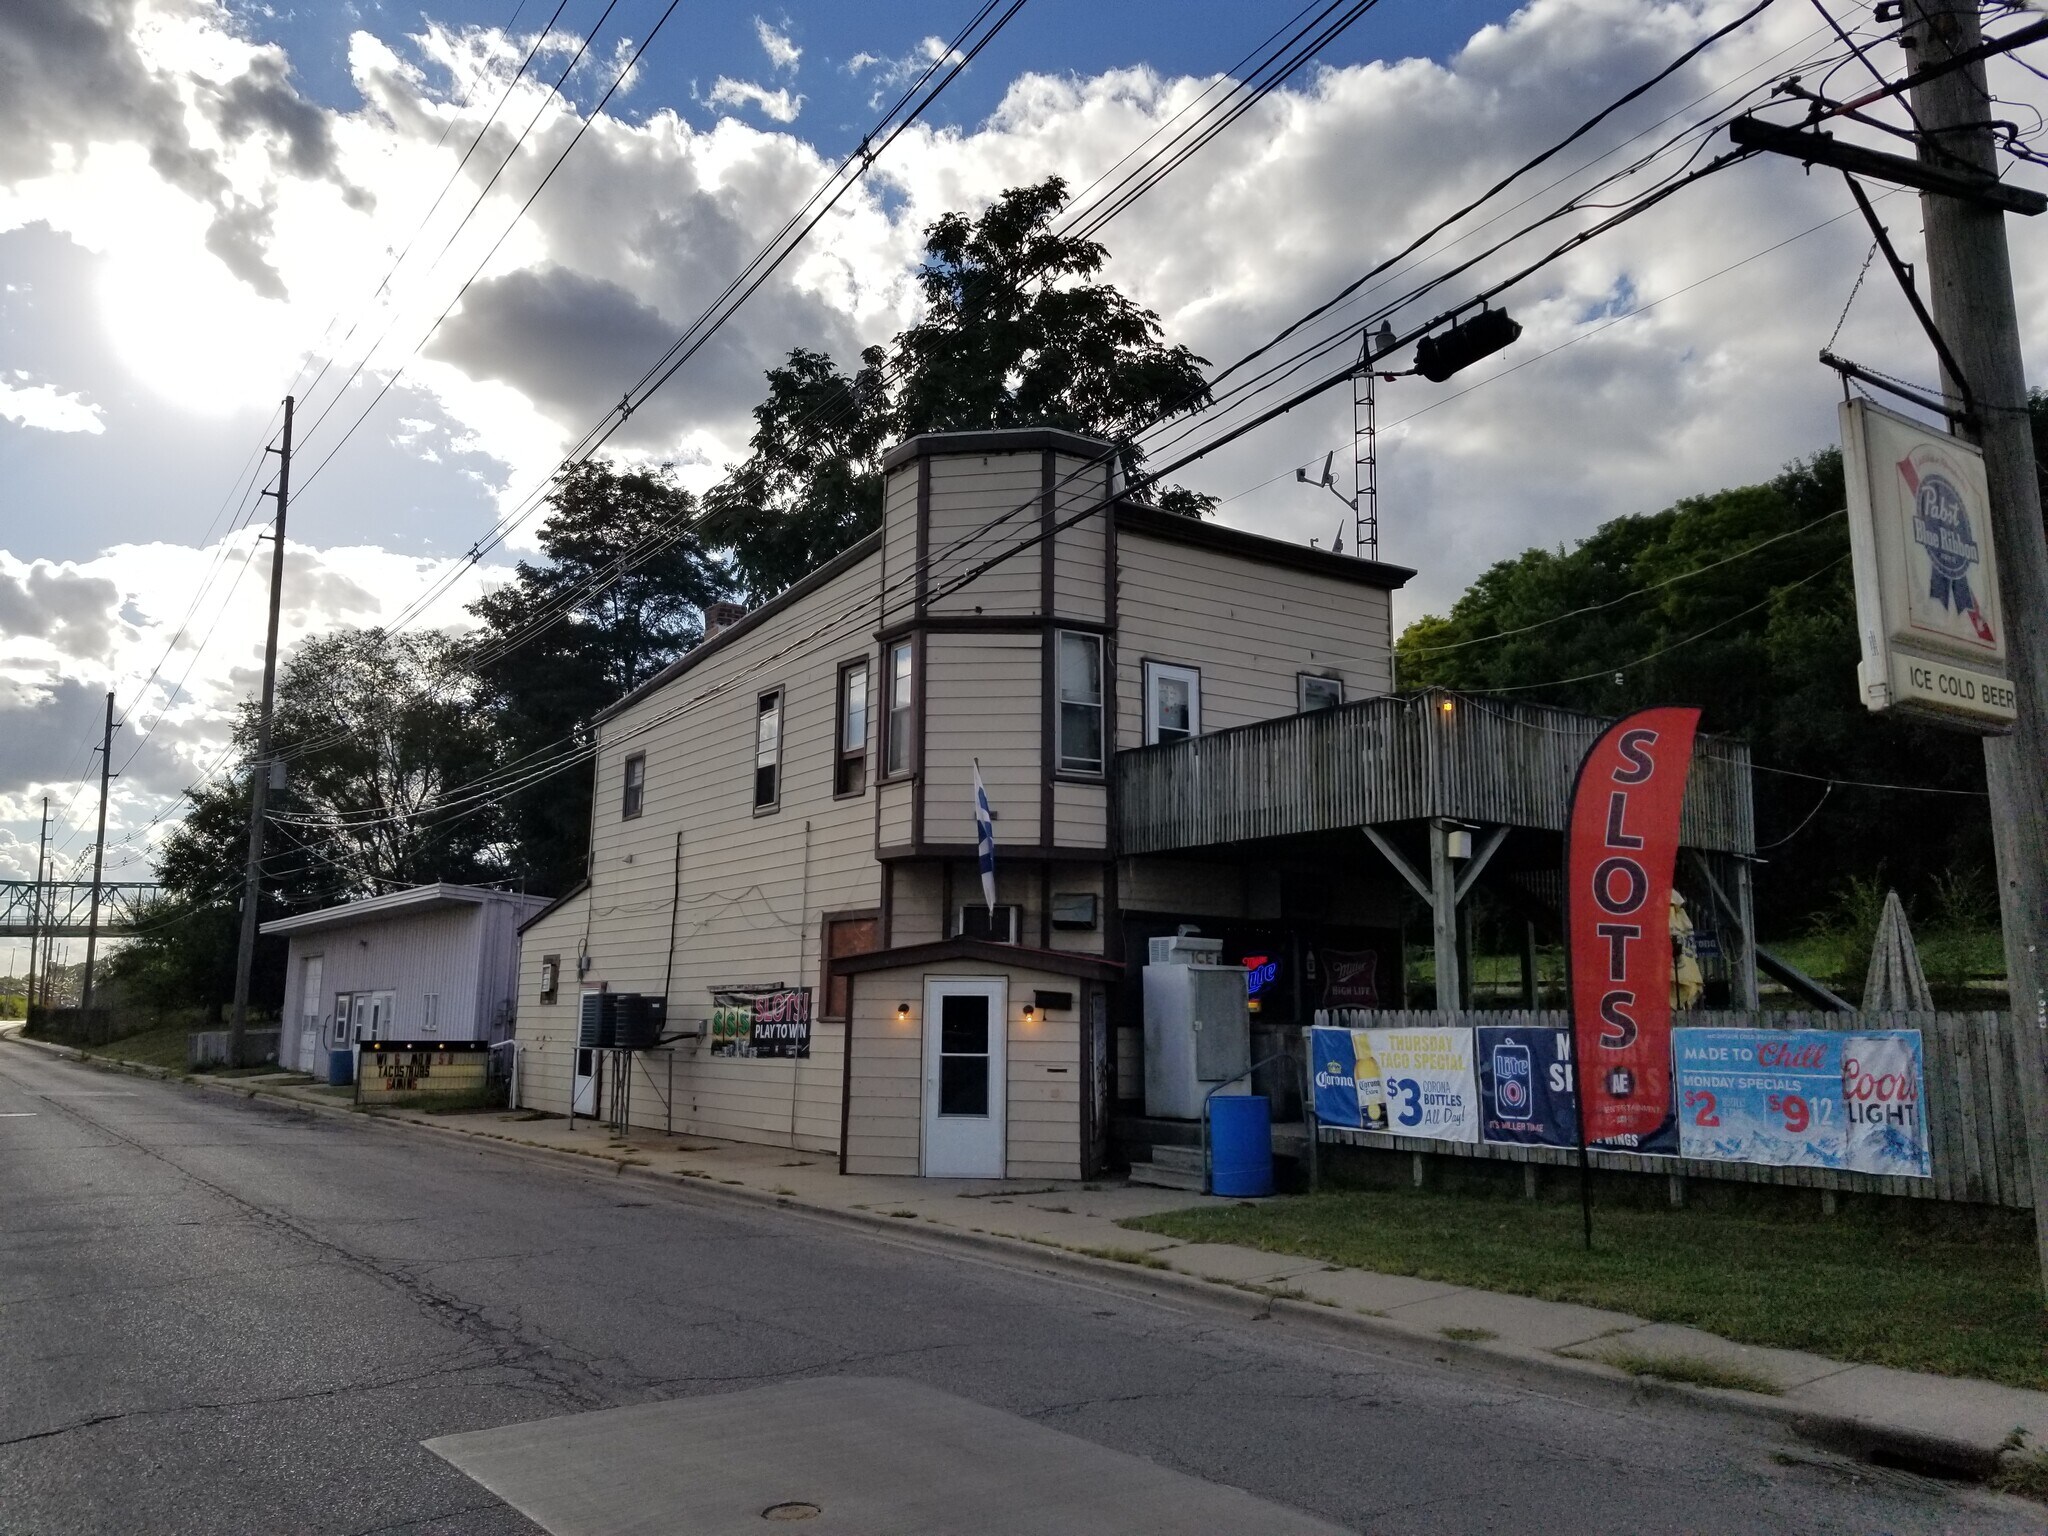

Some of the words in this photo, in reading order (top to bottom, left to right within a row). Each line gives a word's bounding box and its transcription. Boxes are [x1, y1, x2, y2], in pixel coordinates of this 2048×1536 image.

[1921, 485, 1960, 526] Pabst
[1914, 517, 1940, 548] Blue
[1939, 527, 1978, 562] Ribbon
[1909, 666, 1933, 691] ICE
[1938, 673, 1976, 701] COLD
[1981, 682, 2016, 710] BEER
[1591, 727, 1660, 1051] SLOTS
[1191, 950, 1213, 964] ICE
[1333, 961, 1367, 981] Miller
[1332, 986, 1352, 996] HIGH
[1353, 986, 1371, 996] LIFE
[755, 992, 809, 1022] SLOTS!
[755, 1024, 774, 1038] PLAY
[1388, 1035, 1453, 1052] THURSDAY
[1379, 1052, 1410, 1069] TACO
[1414, 1053, 1466, 1071] SPECIAL
[1684, 1047, 1728, 1061] MADE
[1732, 1048, 1753, 1061] TO
[1756, 1041, 1827, 1068] Chill
[1496, 1055, 1528, 1079] Lite
[1316, 1071, 1355, 1089] Corona
[1423, 1080, 1451, 1094] CORONA
[1612, 1073, 1627, 1095] AE
[1682, 1075, 1735, 1089] MONDAY
[1737, 1077, 1802, 1091] SPECIALS
[1842, 1058, 1918, 1102] Coors
[1424, 1094, 1462, 1107] BOTTLES
[1848, 1102, 1914, 1126] LIGHT
[1502, 1121, 1526, 1131] MILLER
[1527, 1122, 1544, 1133] TIME
[1604, 1133, 1639, 1148] WINGS
